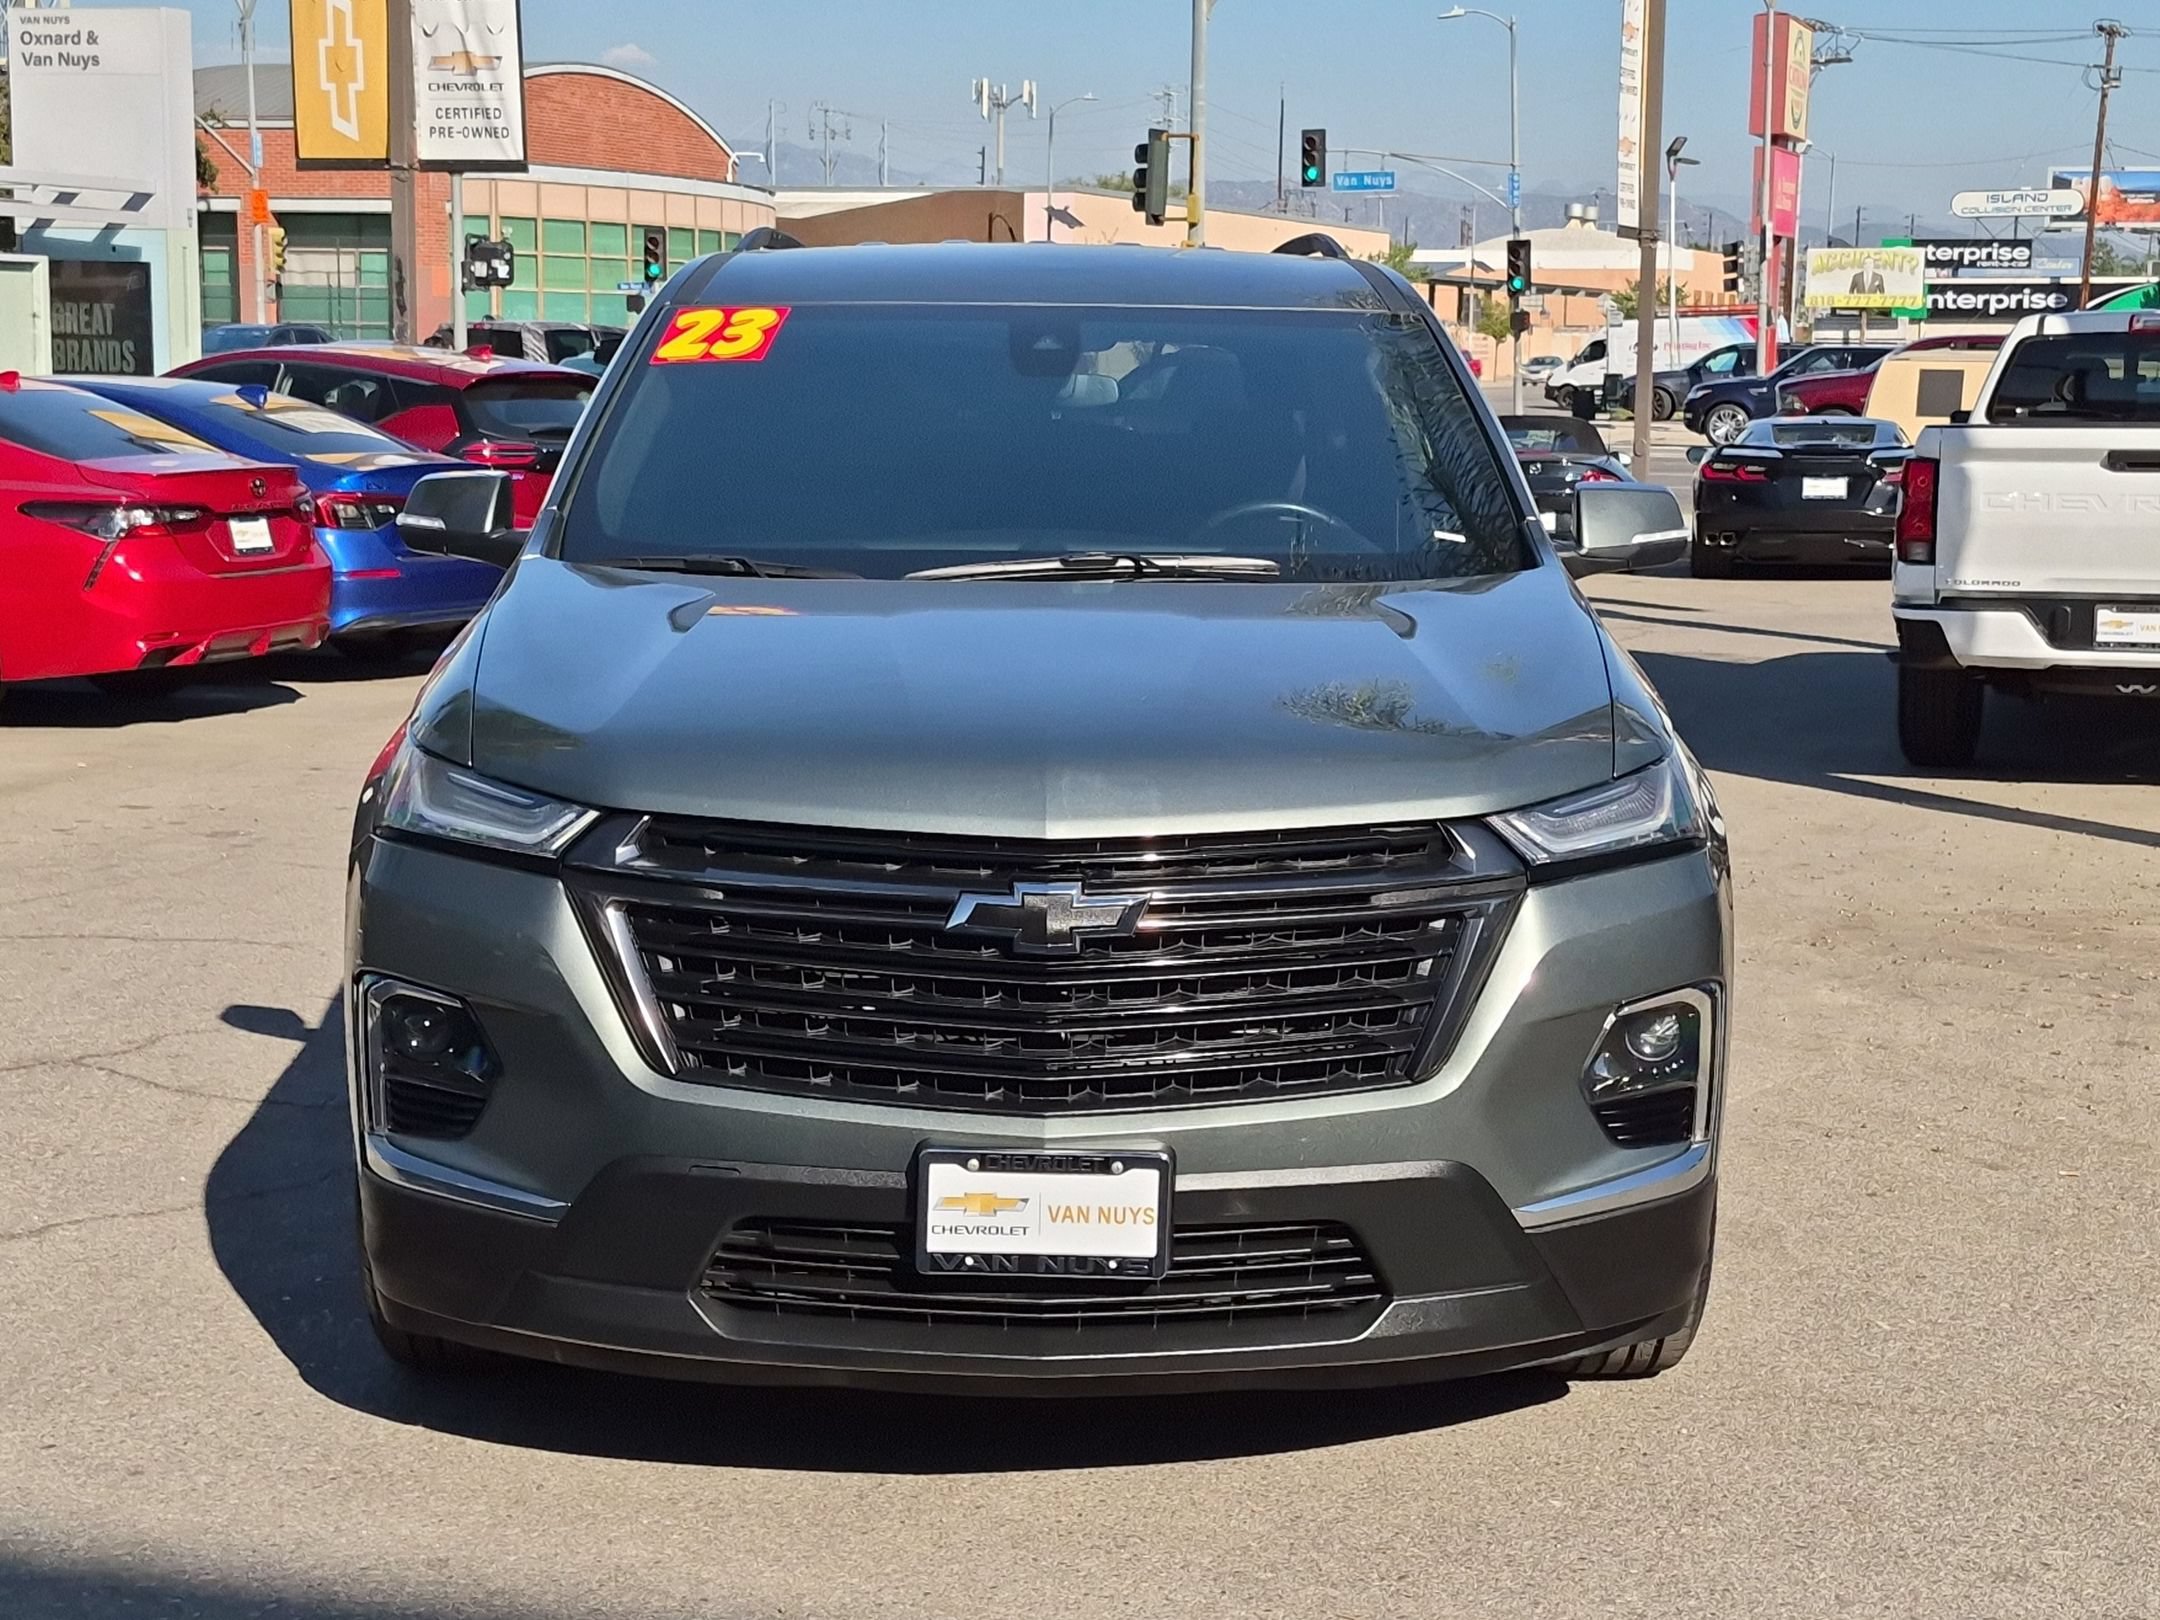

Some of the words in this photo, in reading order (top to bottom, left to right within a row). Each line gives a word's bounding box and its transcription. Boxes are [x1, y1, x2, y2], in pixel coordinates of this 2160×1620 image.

[19, 15, 41, 25] VAN
[43, 15, 70, 25] NUYS
[20, 29, 81, 46] Oxnard
[86, 30, 99, 46] &
[21, 51, 53, 67] Van
[58, 51, 100, 71] Nuys
[428, 82, 505, 92] CHEVROLET
[435, 107, 502, 120] CERTIFIED
[429, 126, 510, 139] PRE-OWNED
[1336, 174, 1358, 187] Van
[1363, 174, 1393, 188] Nuys
[1986, 192, 2049, 204] ISLAND
[2024, 204, 2073, 213] CENTER
[1926, 242, 2031, 265] terprise
[1926, 287, 2069, 315] nterprise
[52, 302, 116, 335] GREAT
[656, 308, 781, 362] 23
[52, 339, 136, 373] BRANDS
[1979, 491, 2160, 514] CHEVR
[984, 1153, 1106, 1173] CHEVROLET
[1047, 1204, 1090, 1225] VAN
[1097, 1205, 1156, 1226] NUYS
[931, 1223, 1031, 1236] CHEVROLET
[931, 1252, 1020, 1273] VAN
[1036, 1255, 1150, 1276] NUYS
